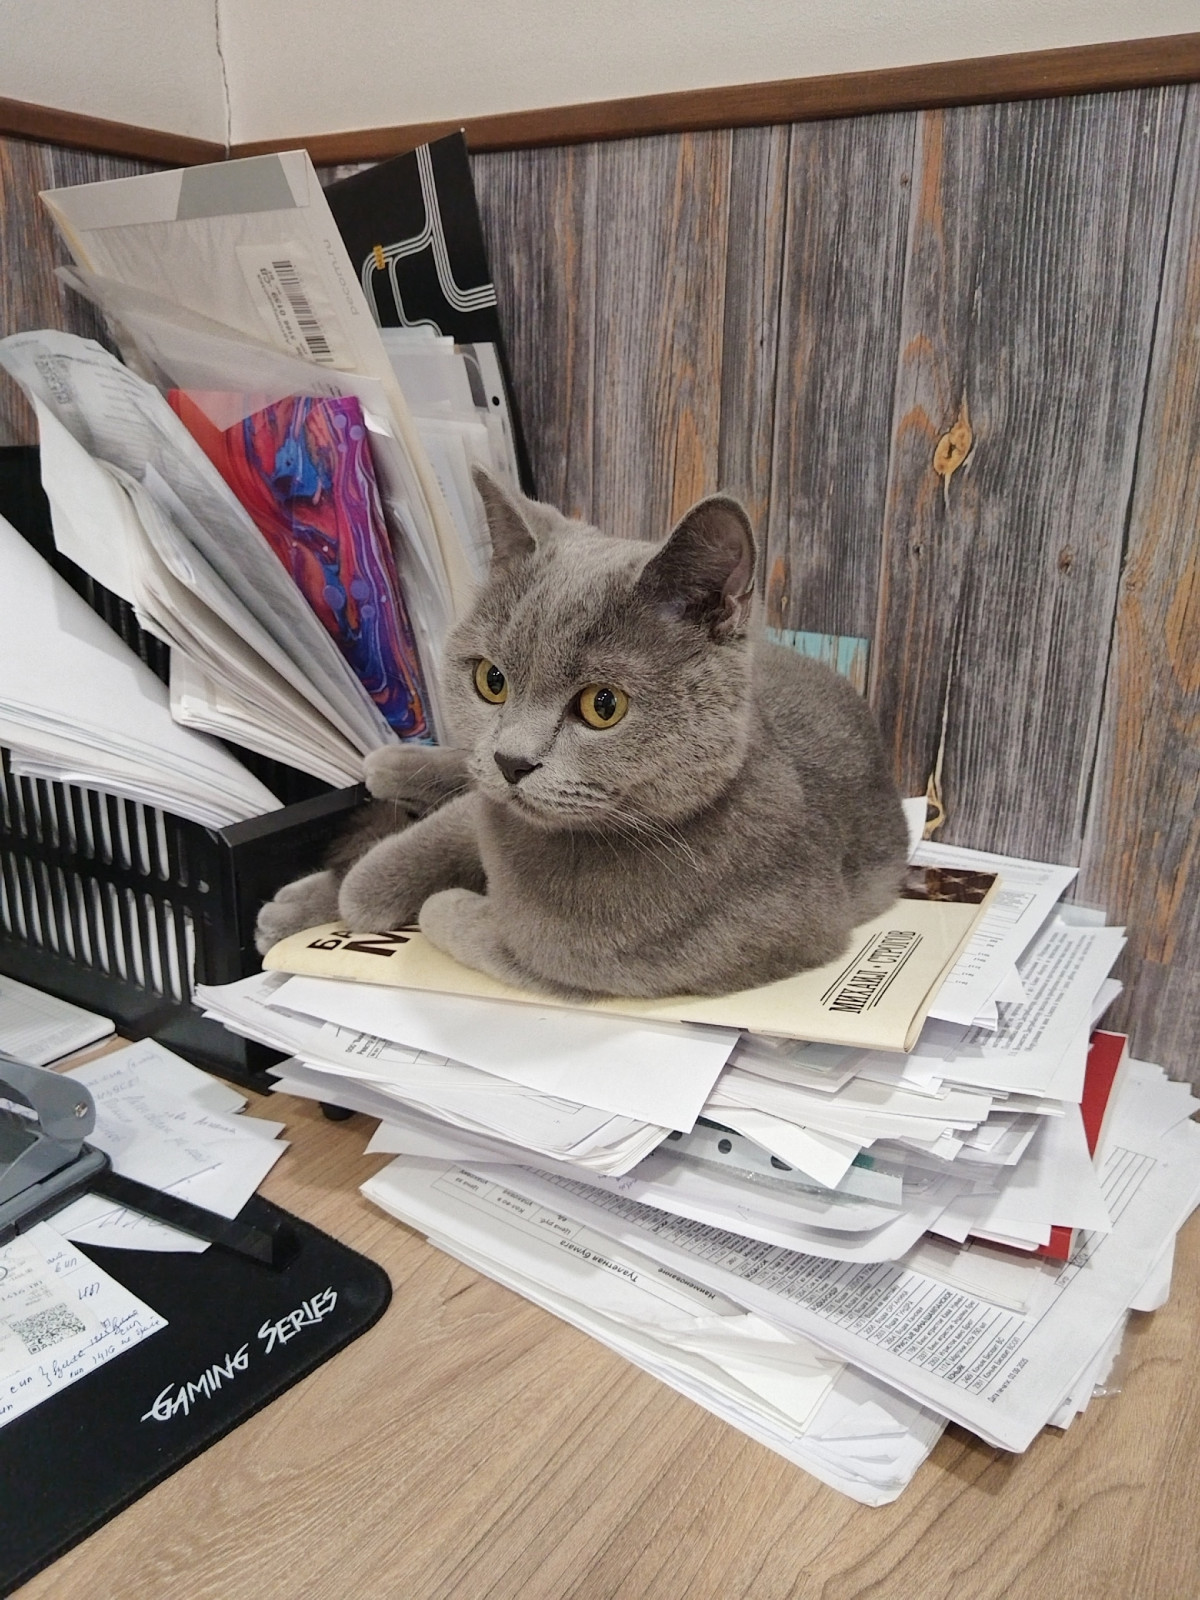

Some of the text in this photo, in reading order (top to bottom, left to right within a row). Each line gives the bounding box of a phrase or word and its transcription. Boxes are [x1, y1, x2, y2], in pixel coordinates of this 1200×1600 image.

[829, 930, 916, 1014] МИХАИЛ СТРОГОВ
[560, 1239, 639, 1284] Туалетная бумага
[658, 1267, 716, 1300] Наименование
[140, 1286, 338, 1422] GAMING SERIES
